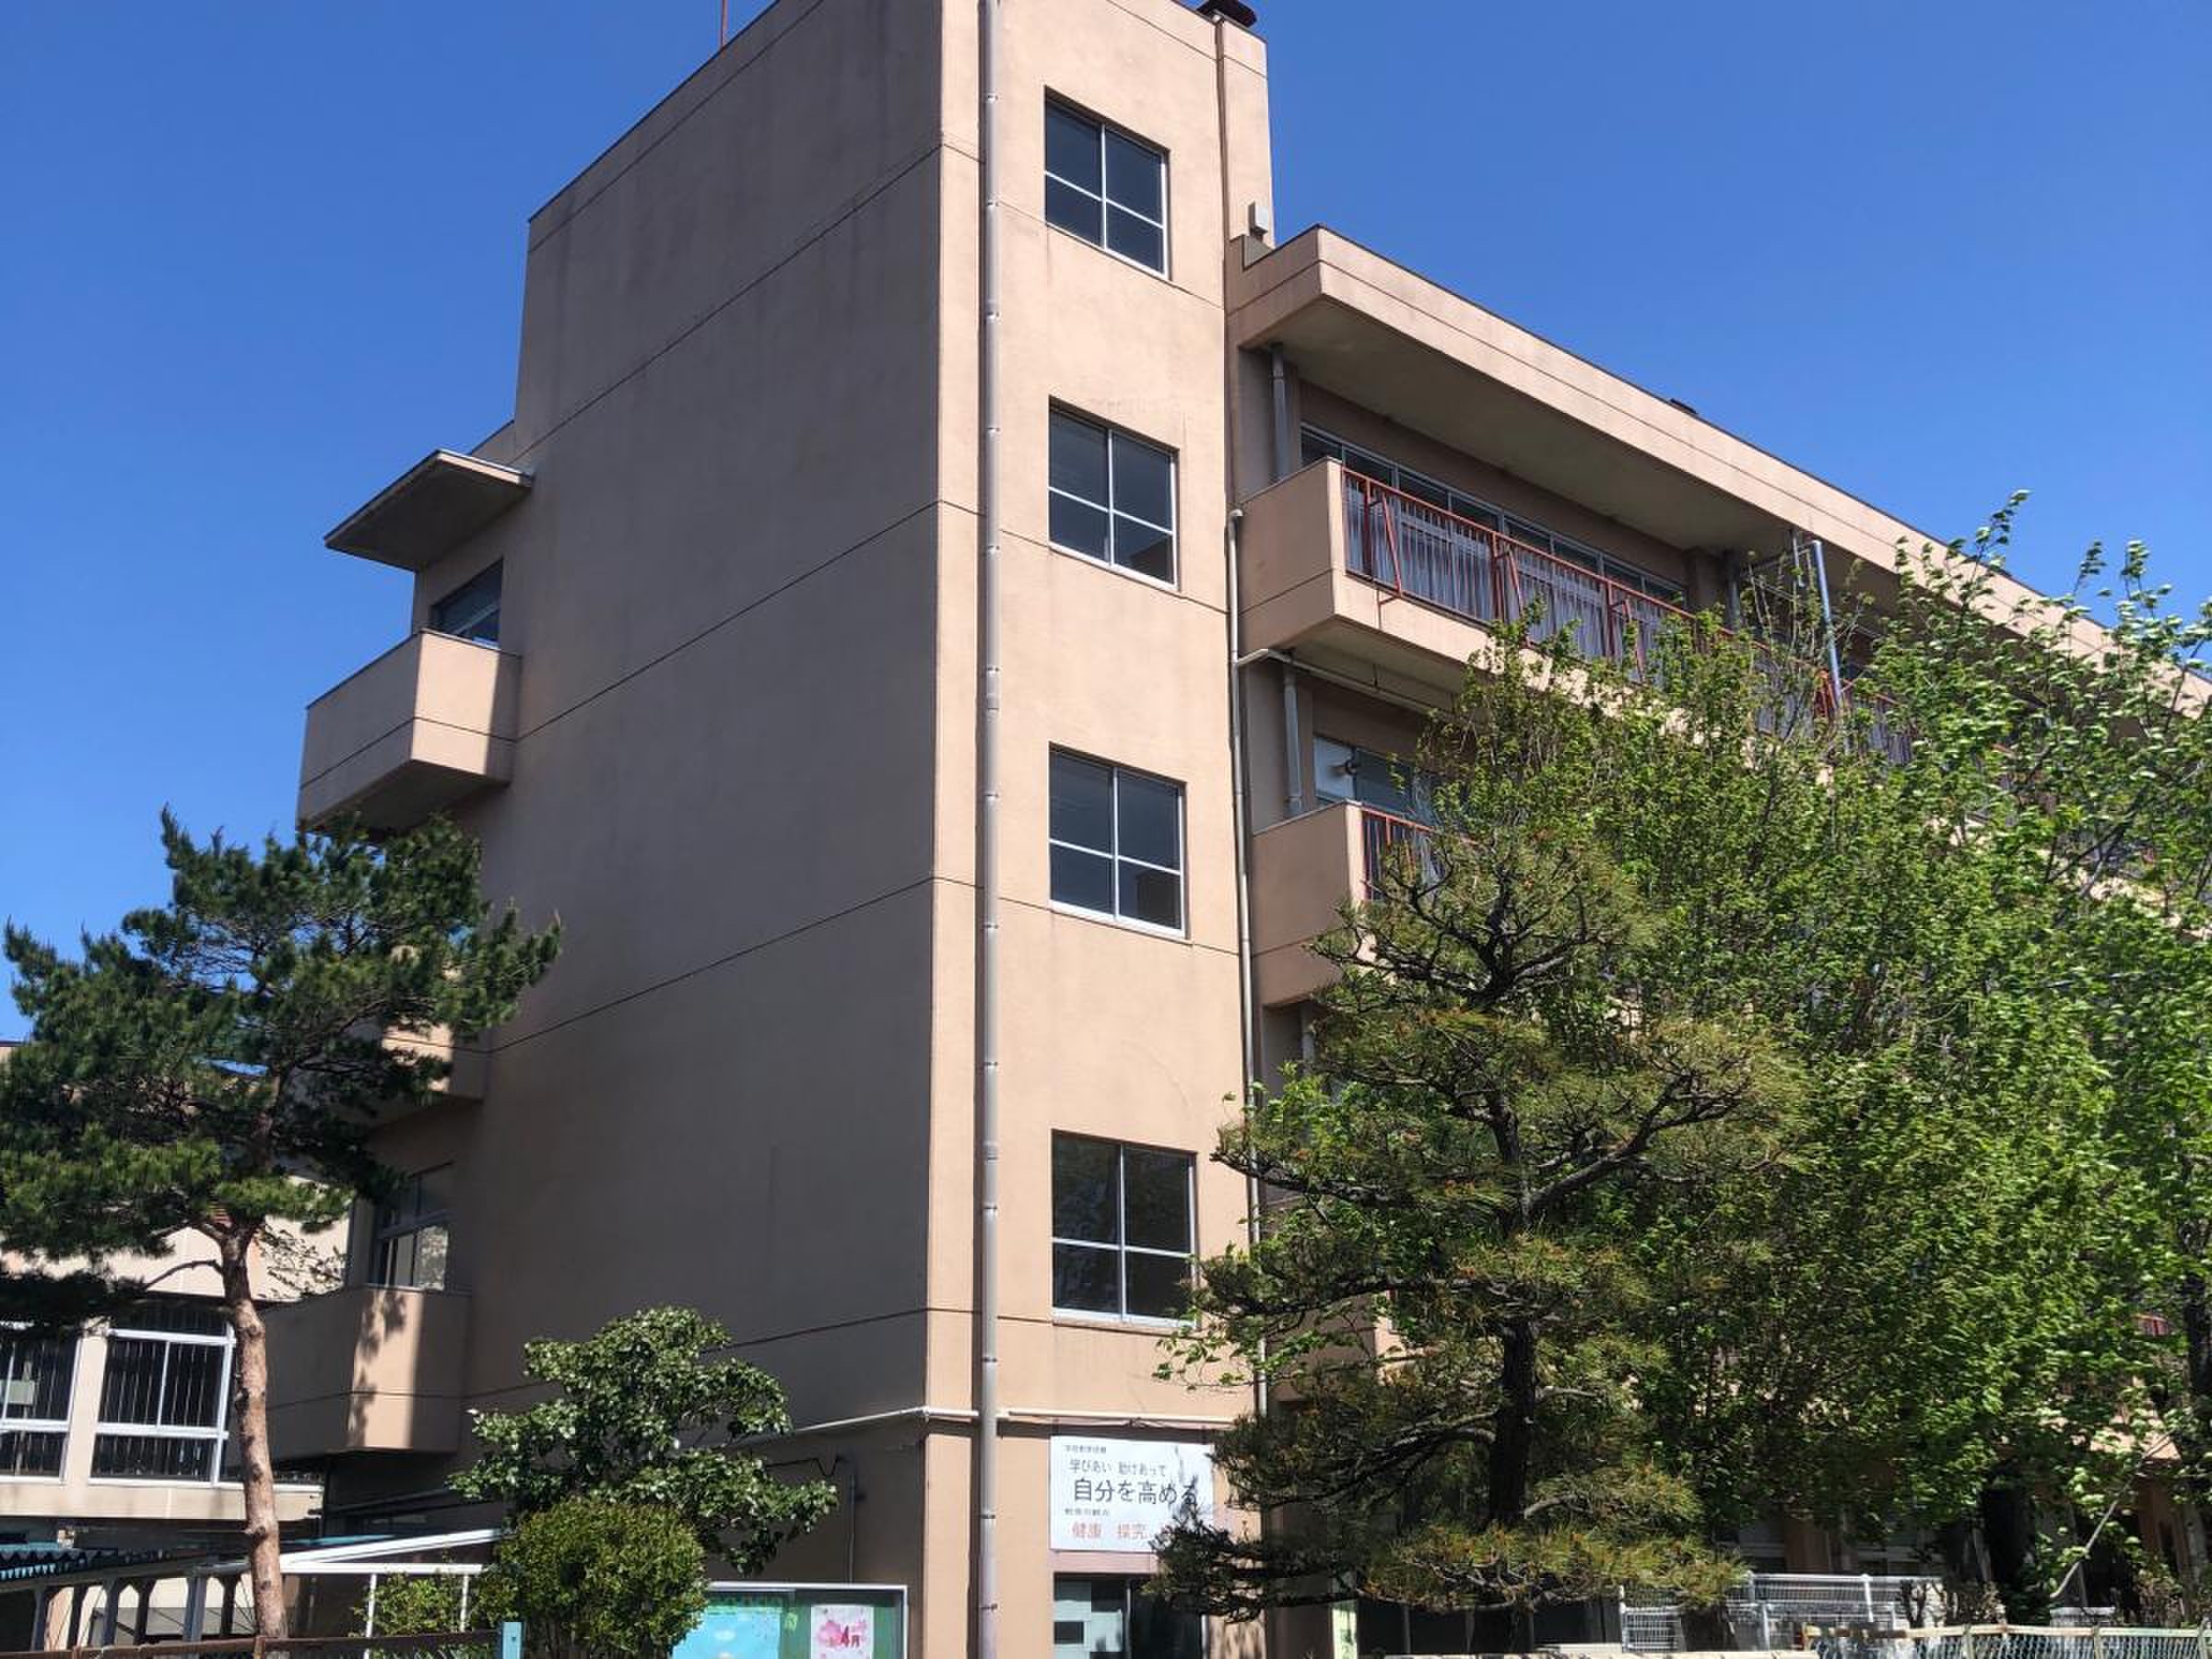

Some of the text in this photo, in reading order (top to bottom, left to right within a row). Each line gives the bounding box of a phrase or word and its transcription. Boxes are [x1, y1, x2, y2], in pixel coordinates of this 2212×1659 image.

[1069, 1459, 1112, 1473] 学びあい
[1074, 1478, 1197, 1505] 自分を高める
